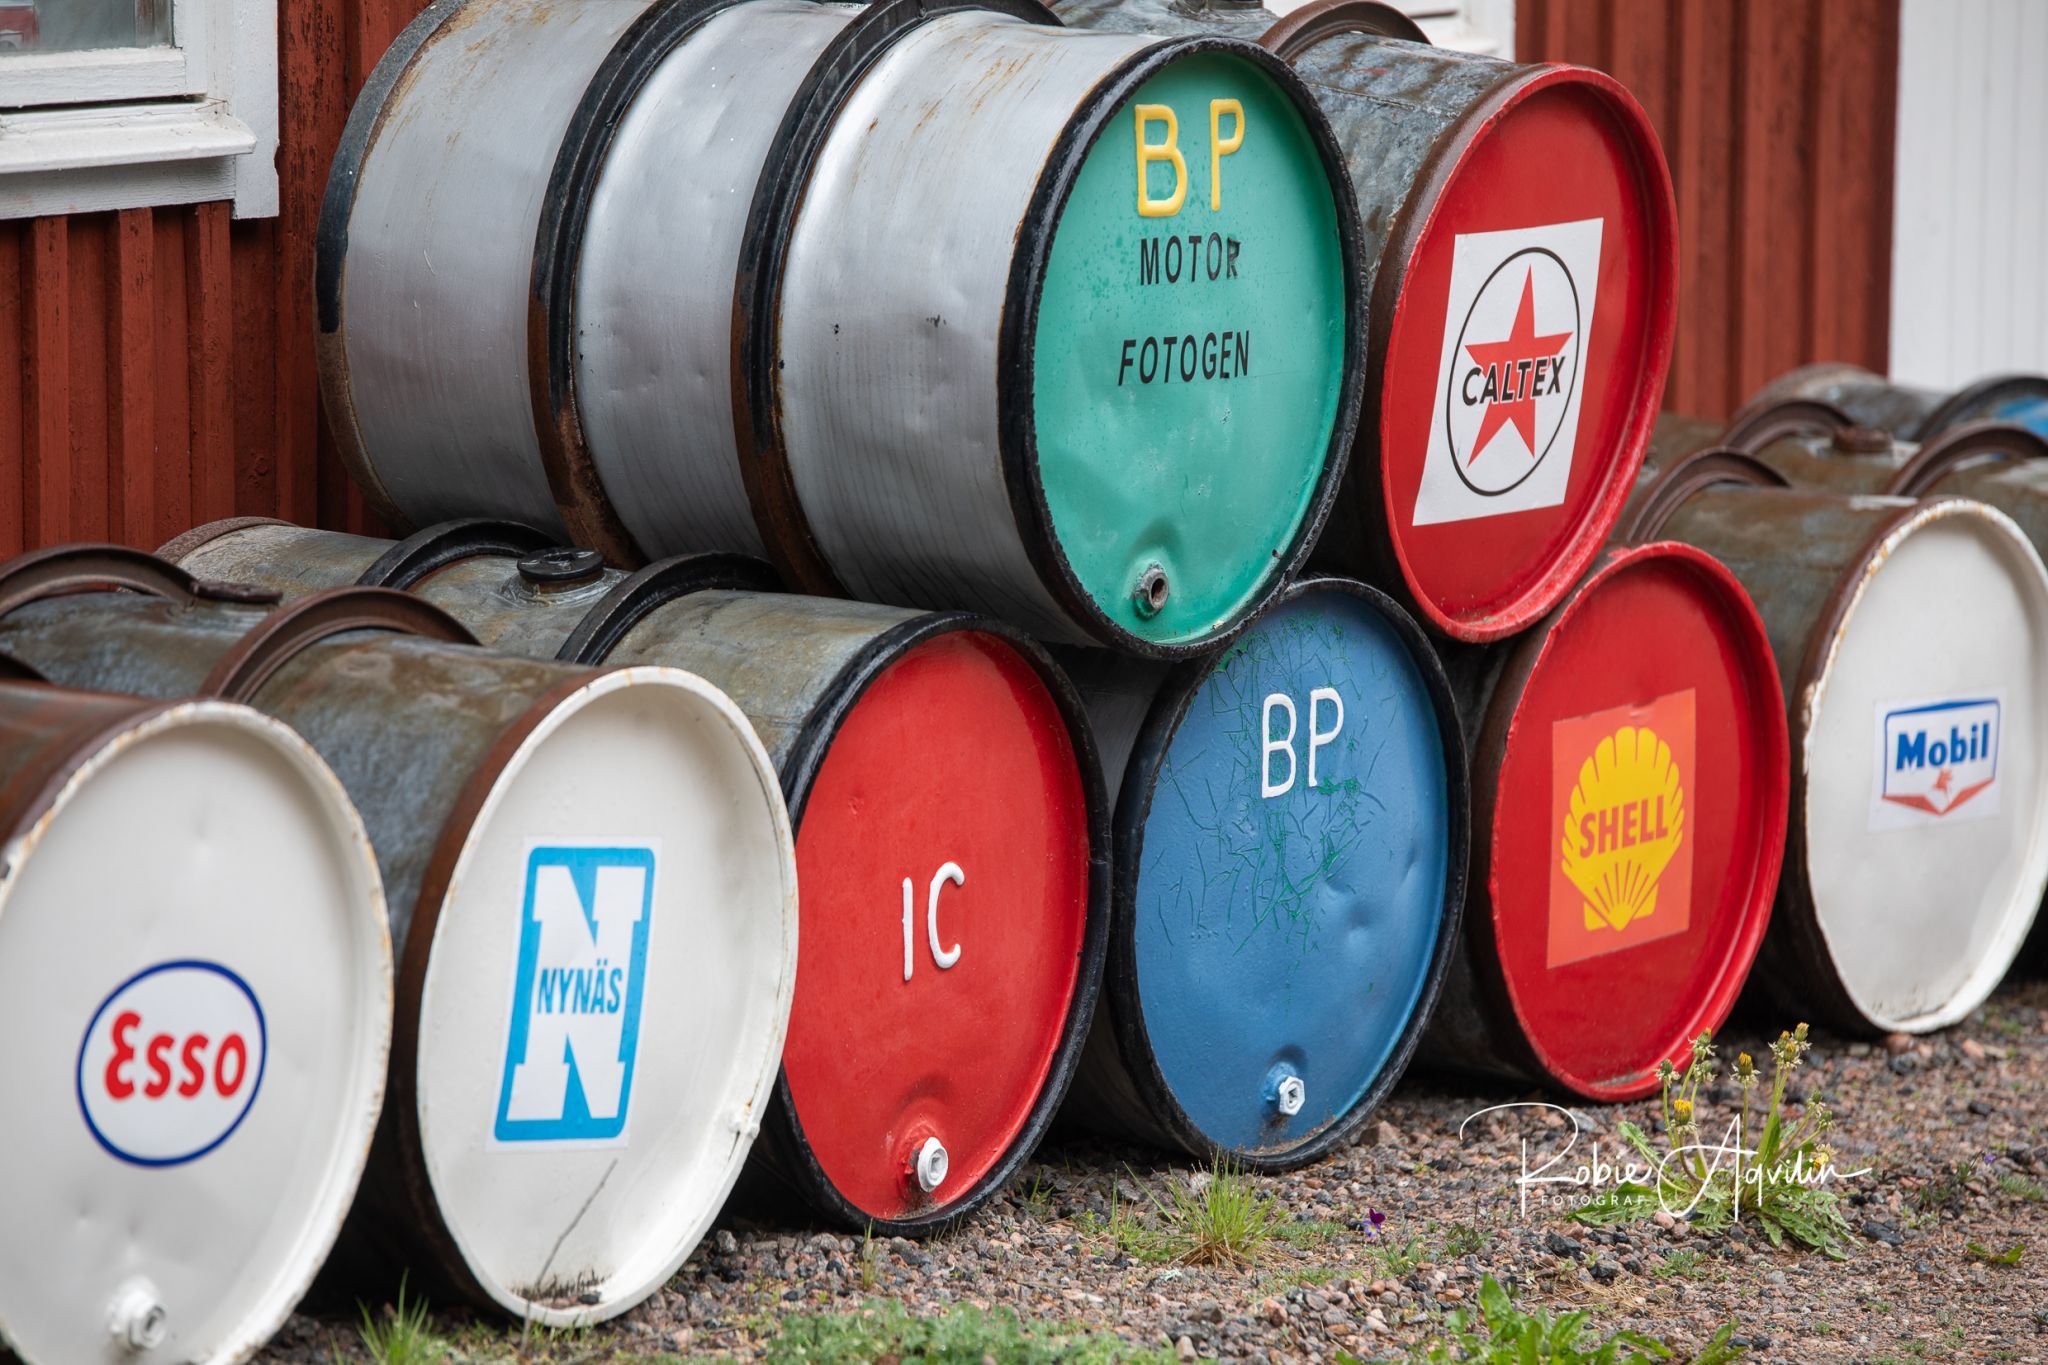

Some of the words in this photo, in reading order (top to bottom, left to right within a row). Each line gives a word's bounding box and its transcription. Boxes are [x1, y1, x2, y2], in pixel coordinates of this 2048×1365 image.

[1140, 231, 1241, 286] MOTOR
[1118, 330, 1249, 386] FOTOGEN
[1462, 355, 1566, 406] CALTEX
[1262, 687, 1344, 799] BP
[1896, 721, 1990, 771] Mobil
[1580, 795, 1669, 858] SHELL
[537, 958, 623, 1014] NYNÄS
